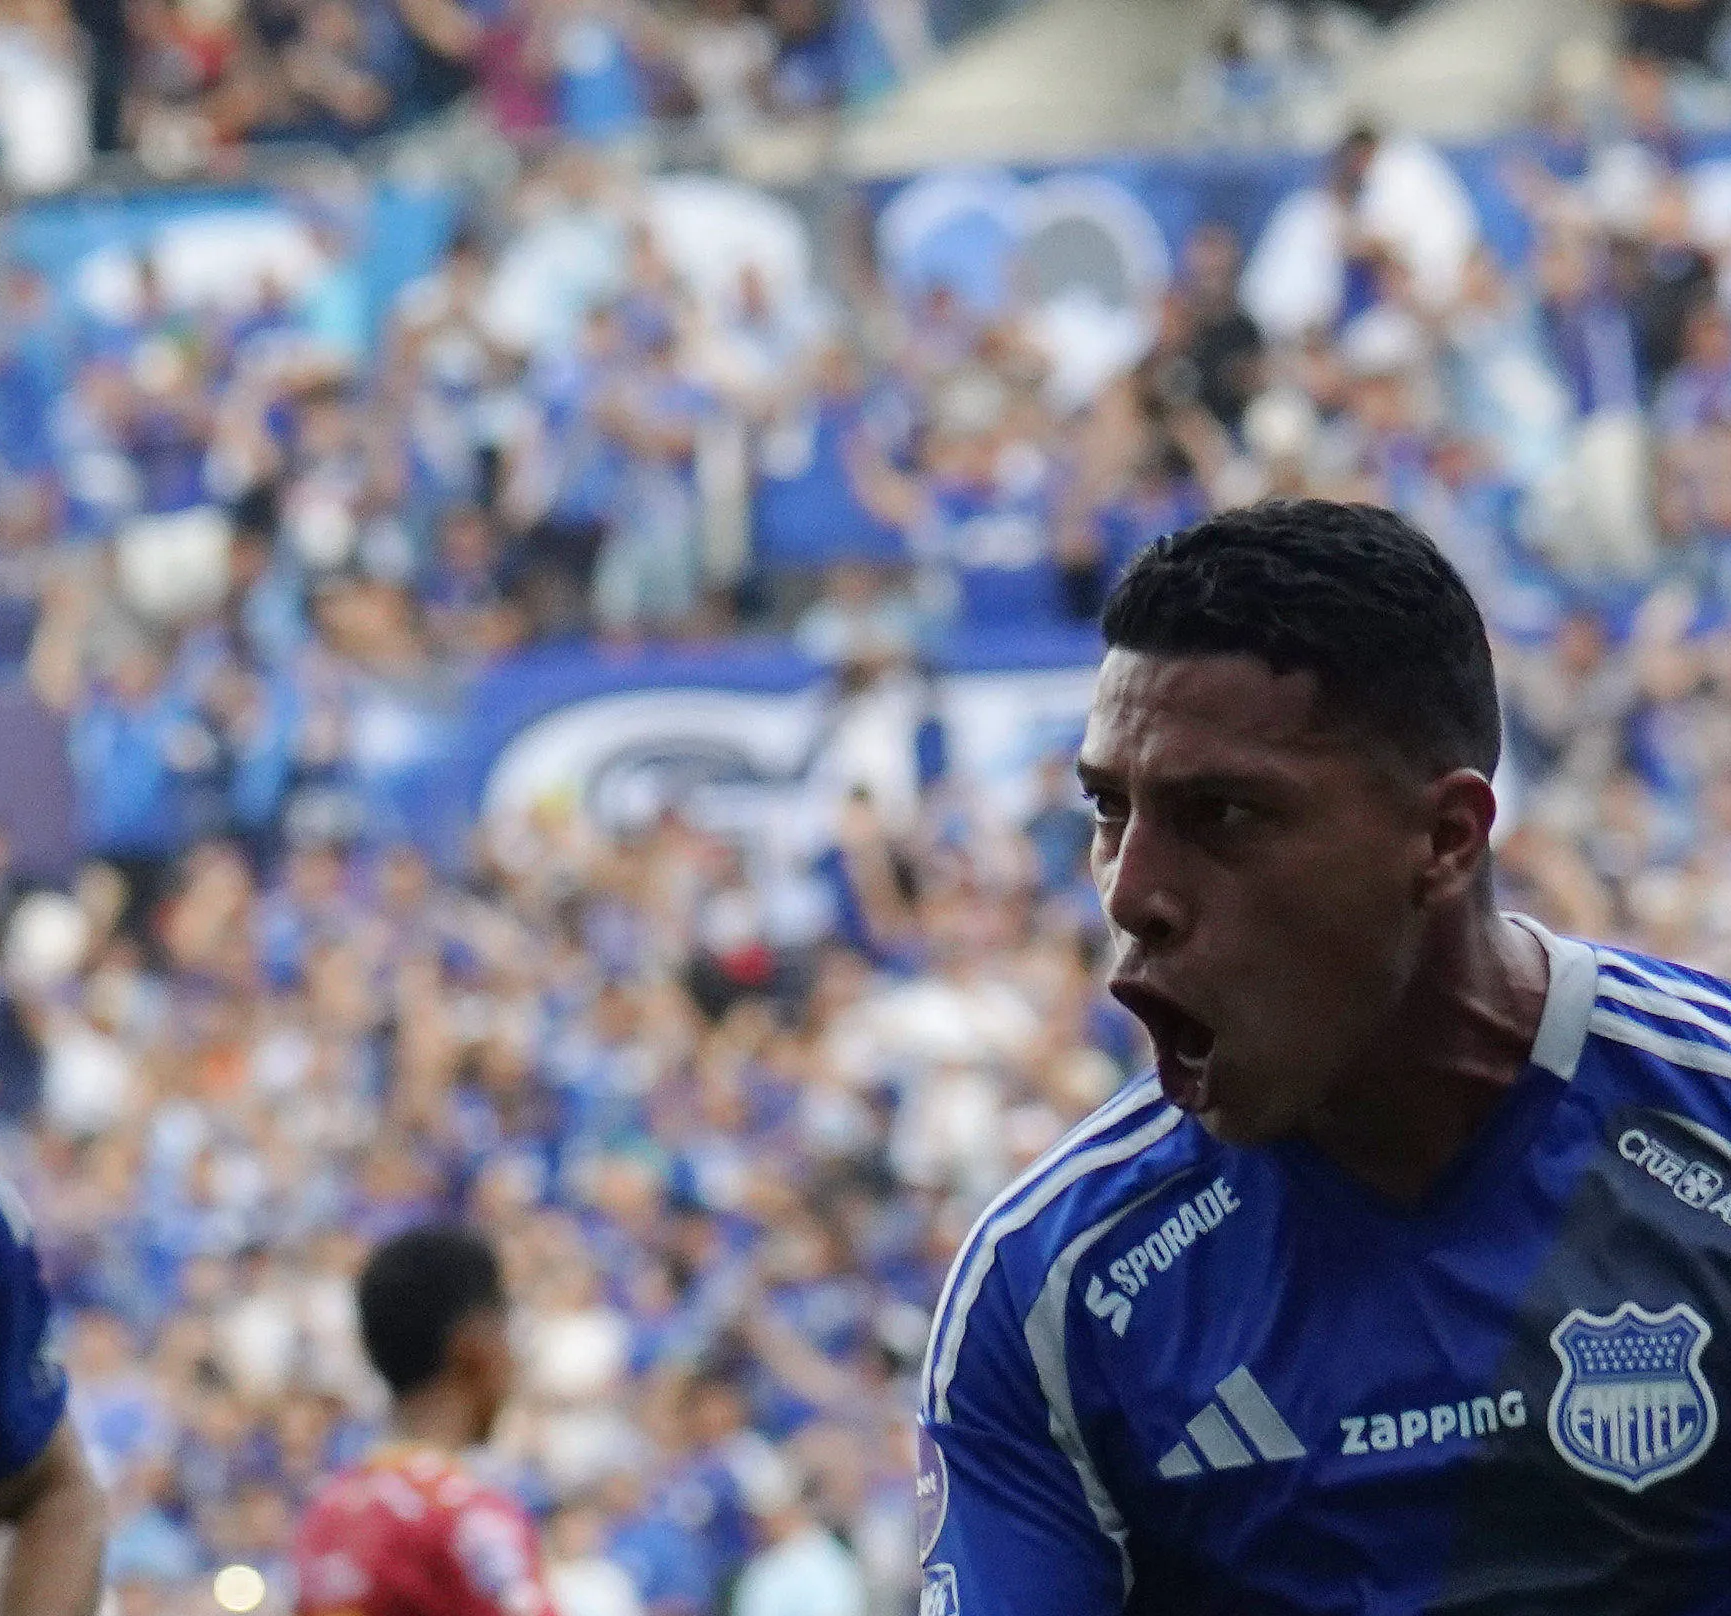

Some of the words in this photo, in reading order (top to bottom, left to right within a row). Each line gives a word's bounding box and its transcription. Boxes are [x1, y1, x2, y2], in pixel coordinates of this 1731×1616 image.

[1617, 1128, 1688, 1187] Cruz
[1109, 1176, 1242, 1297] SPORADE
[1570, 1383, 1696, 1467] EMELEC
